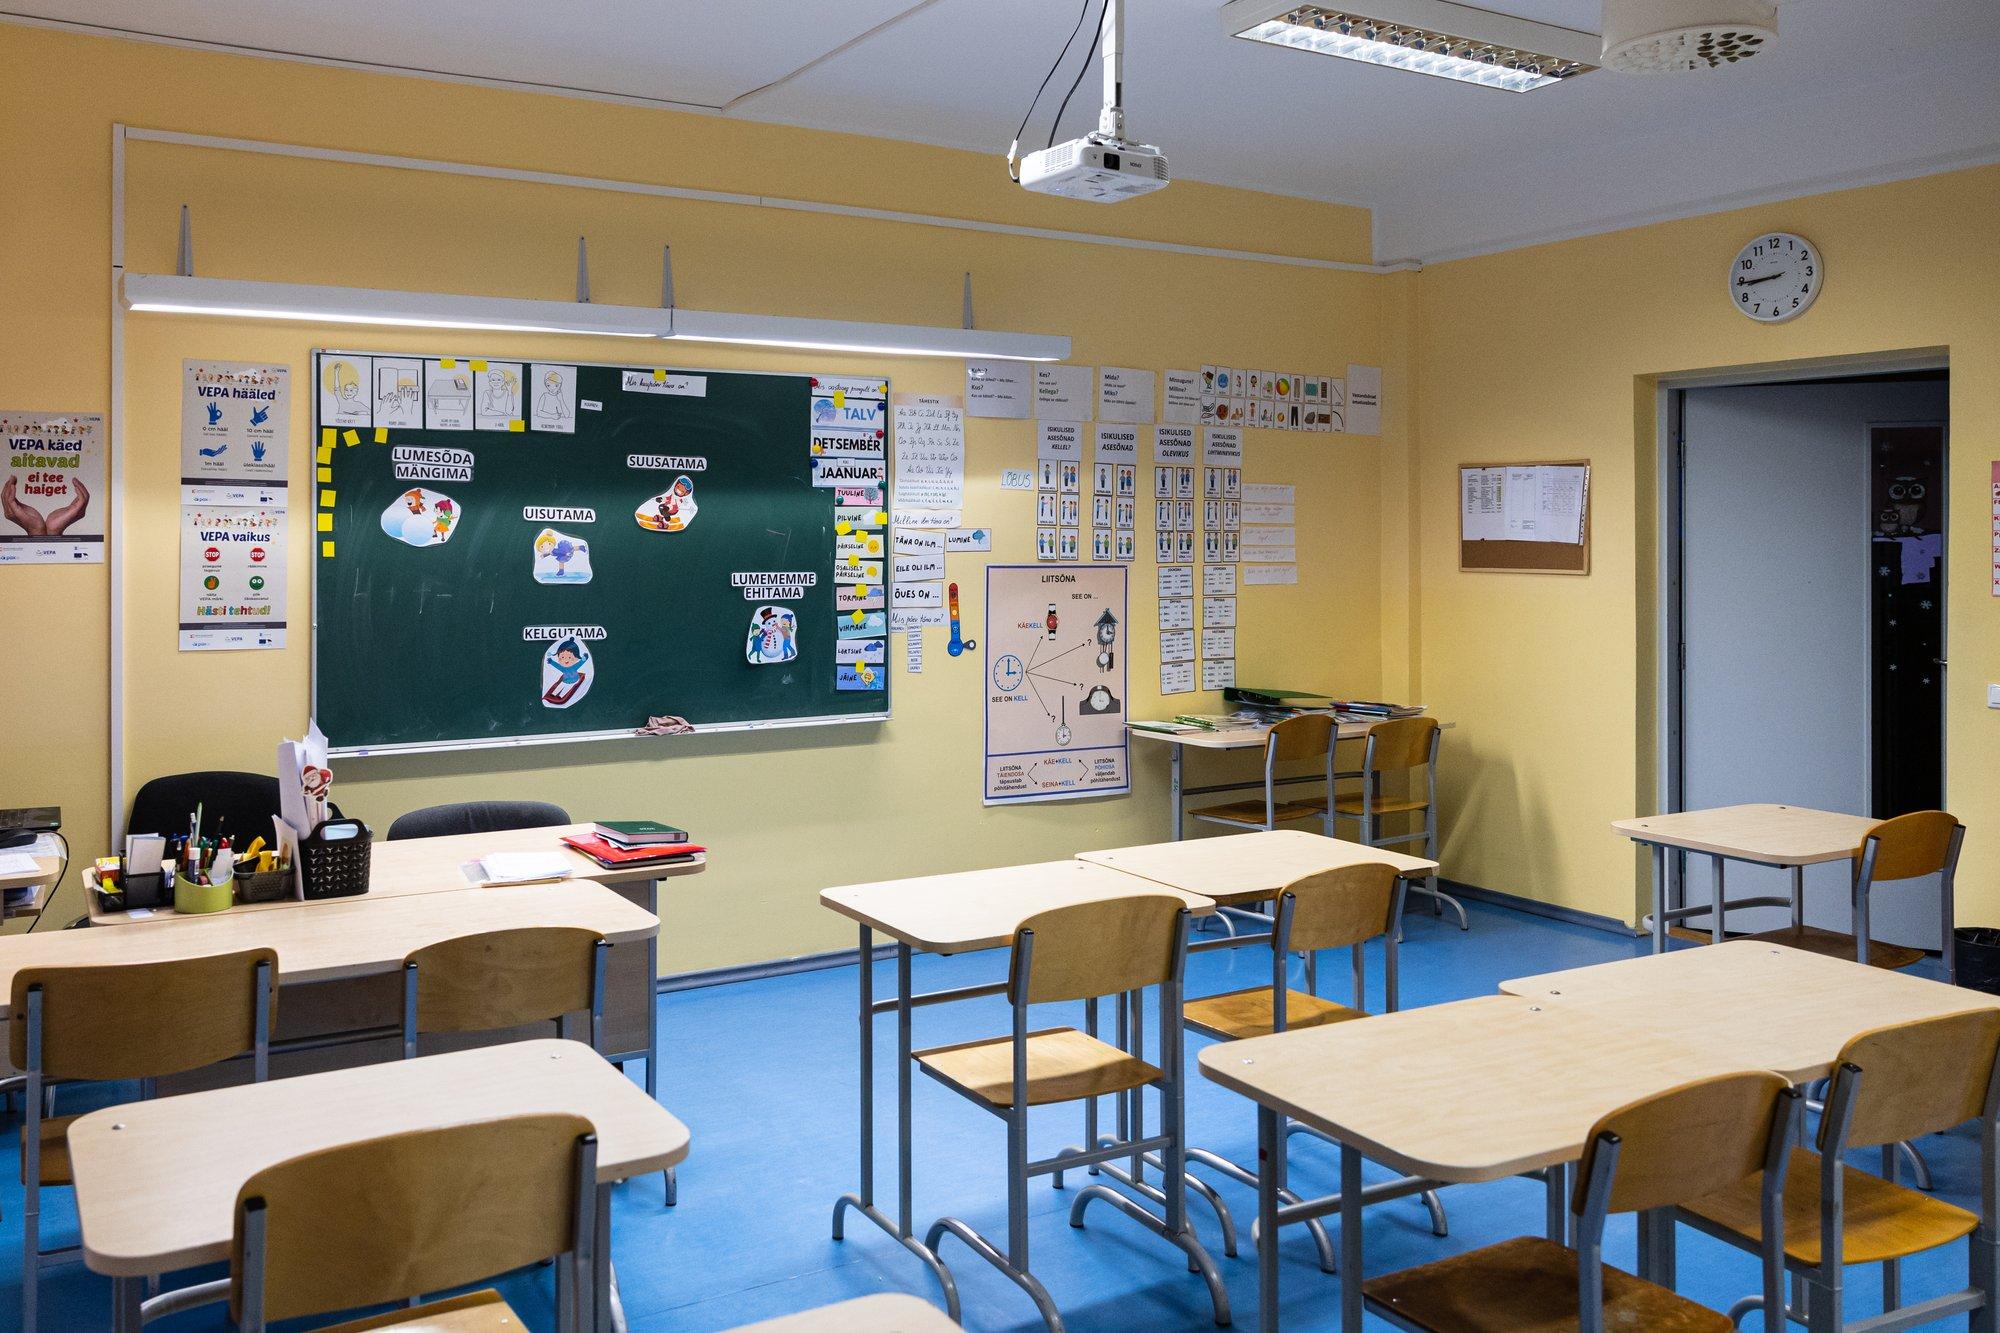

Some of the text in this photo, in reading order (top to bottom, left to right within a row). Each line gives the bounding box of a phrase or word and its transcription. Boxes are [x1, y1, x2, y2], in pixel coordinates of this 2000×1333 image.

[1768, 238, 1780, 249] 12
[1788, 241, 1793, 250] 1
[1753, 246, 1763, 256] 11
[1801, 250, 1808, 261] 2
[1741, 259, 1752, 270] 10
[1806, 266, 1813, 276] 3
[1739, 277, 1745, 286] 9
[1801, 283, 1809, 294] 4
[1742, 293, 1749, 302] 8
[1792, 297, 1799, 308] 5
[1754, 303, 1760, 313] 7
[1773, 307, 1779, 316] 6
[198, 386, 276, 400] VEPA hääled
[844, 407, 876, 421] TALV
[1101, 433, 1135, 441] ISIKULISED
[1159, 428, 1192, 436] ISIKULISED
[9, 439, 82, 451] VEPA käed
[813, 437, 881, 451] DETSEMBER
[1102, 442, 1134, 452] ASESÕNAD
[1159, 438, 1191, 447] ASESÕNAD
[1212, 441, 1237, 449] ASESÕNAD
[393, 448, 472, 465] LUMESÕDA
[1162, 450, 1189, 458] OLEVIKUS
[10, 454, 80, 468] aitavad
[629, 456, 705, 470] SUUSATAMA
[396, 464, 469, 479] MÄNGIMA
[820, 467, 878, 479] JAANUAR
[28, 472, 63, 483] ei tee
[24, 484, 67, 497] haiget
[838, 489, 864, 497] TUULINE
[525, 508, 593, 522] UISUTAMA
[837, 514, 861, 522] PILVINE
[200, 532, 270, 542] VEPA vaikus
[896, 536, 936, 548] TÄNA ON ILM
[948, 536, 971, 544] LUMINE
[837, 542, 864, 550] PÄIKSELINE
[733, 573, 815, 585] LUMEMEMME
[1041, 574, 1076, 584] LIITSÕNA
[745, 587, 802, 600] EHITAMA
[894, 588, 930, 599] ÕUES ON
[197, 605, 271, 616] Hästi tehtud!
[839, 623, 867, 632] VIHMANE
[1017, 621, 1043, 629] KÄEKELL
[524, 627, 605, 640] KELGUTAMA
[1087, 638, 1092, 647] ?
[839, 674, 857, 682] JÄINE
[1079, 683, 1084, 691] ?
[1051, 715, 1056, 723] ?
